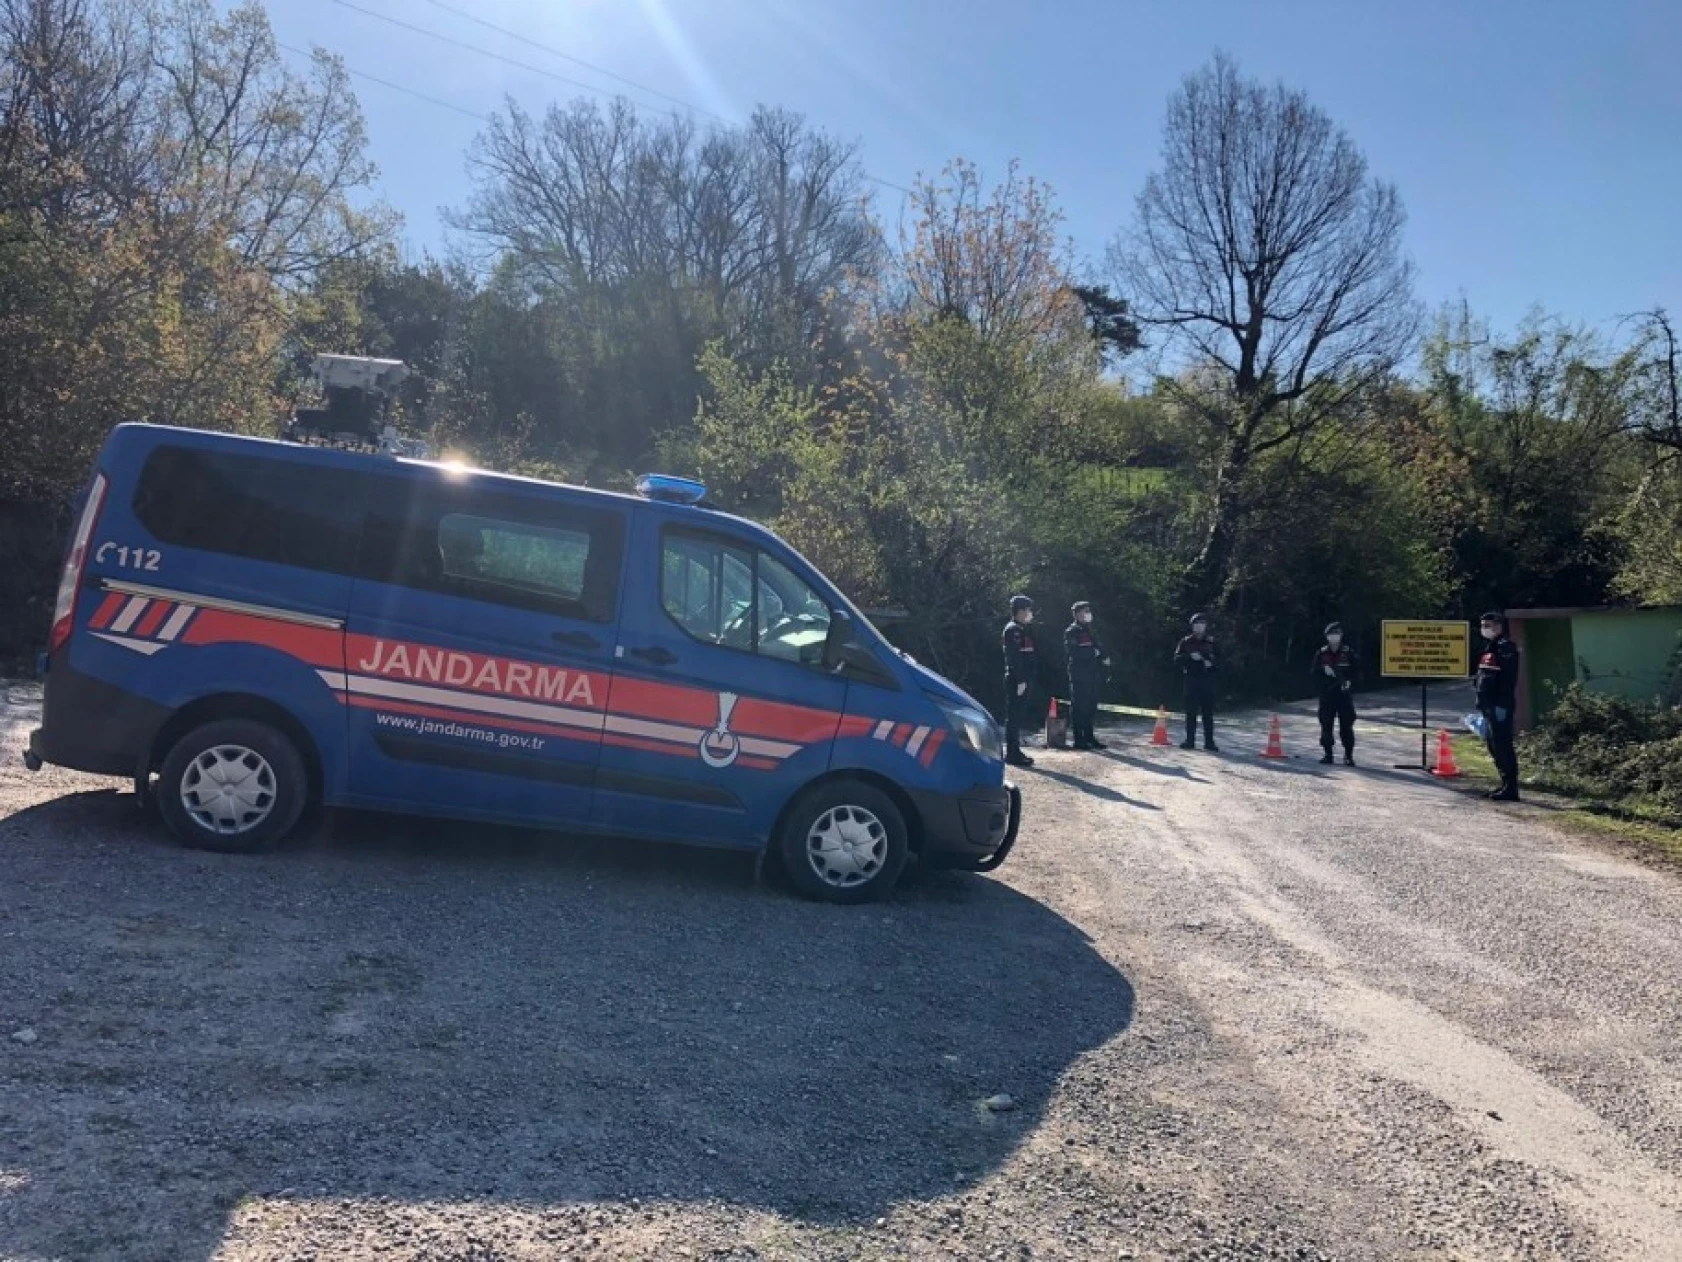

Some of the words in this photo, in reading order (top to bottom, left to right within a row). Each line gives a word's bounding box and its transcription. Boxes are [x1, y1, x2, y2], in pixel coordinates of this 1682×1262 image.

[117, 546, 161, 571] 112
[360, 641, 595, 706] JANDARMA
[375, 713, 546, 750] www.jandarma.gov.tr
